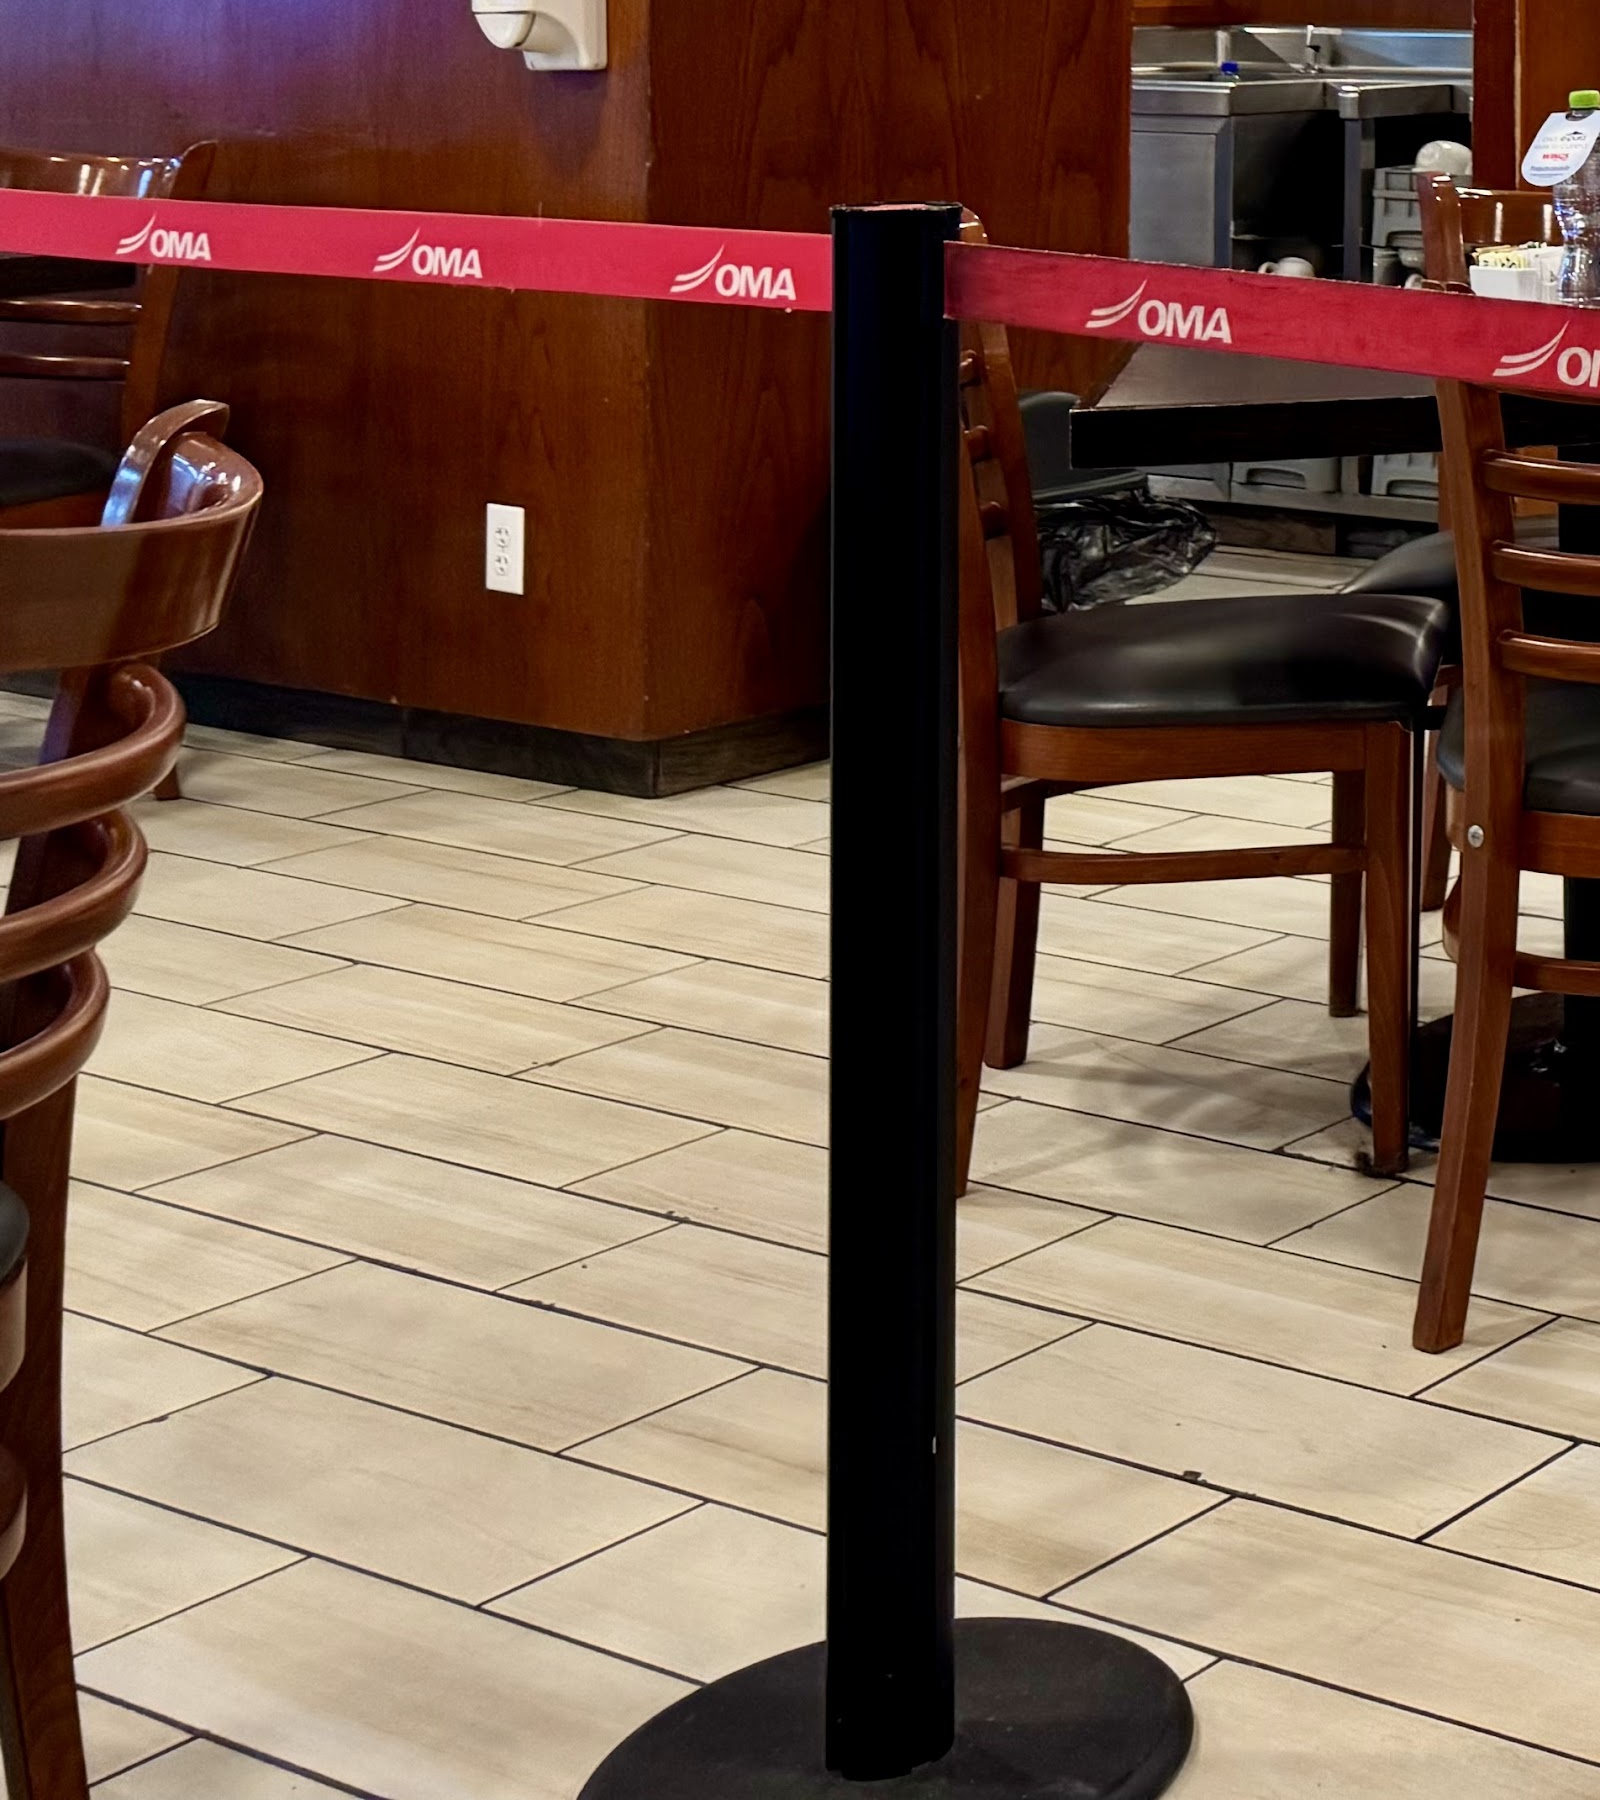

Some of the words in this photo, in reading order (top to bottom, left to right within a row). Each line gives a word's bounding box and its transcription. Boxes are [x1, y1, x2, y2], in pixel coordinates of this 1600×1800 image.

[150, 228, 211, 261] OMA
[412, 244, 483, 279] OMA
[714, 263, 797, 301] OMA
[1137, 299, 1232, 344] OMA
